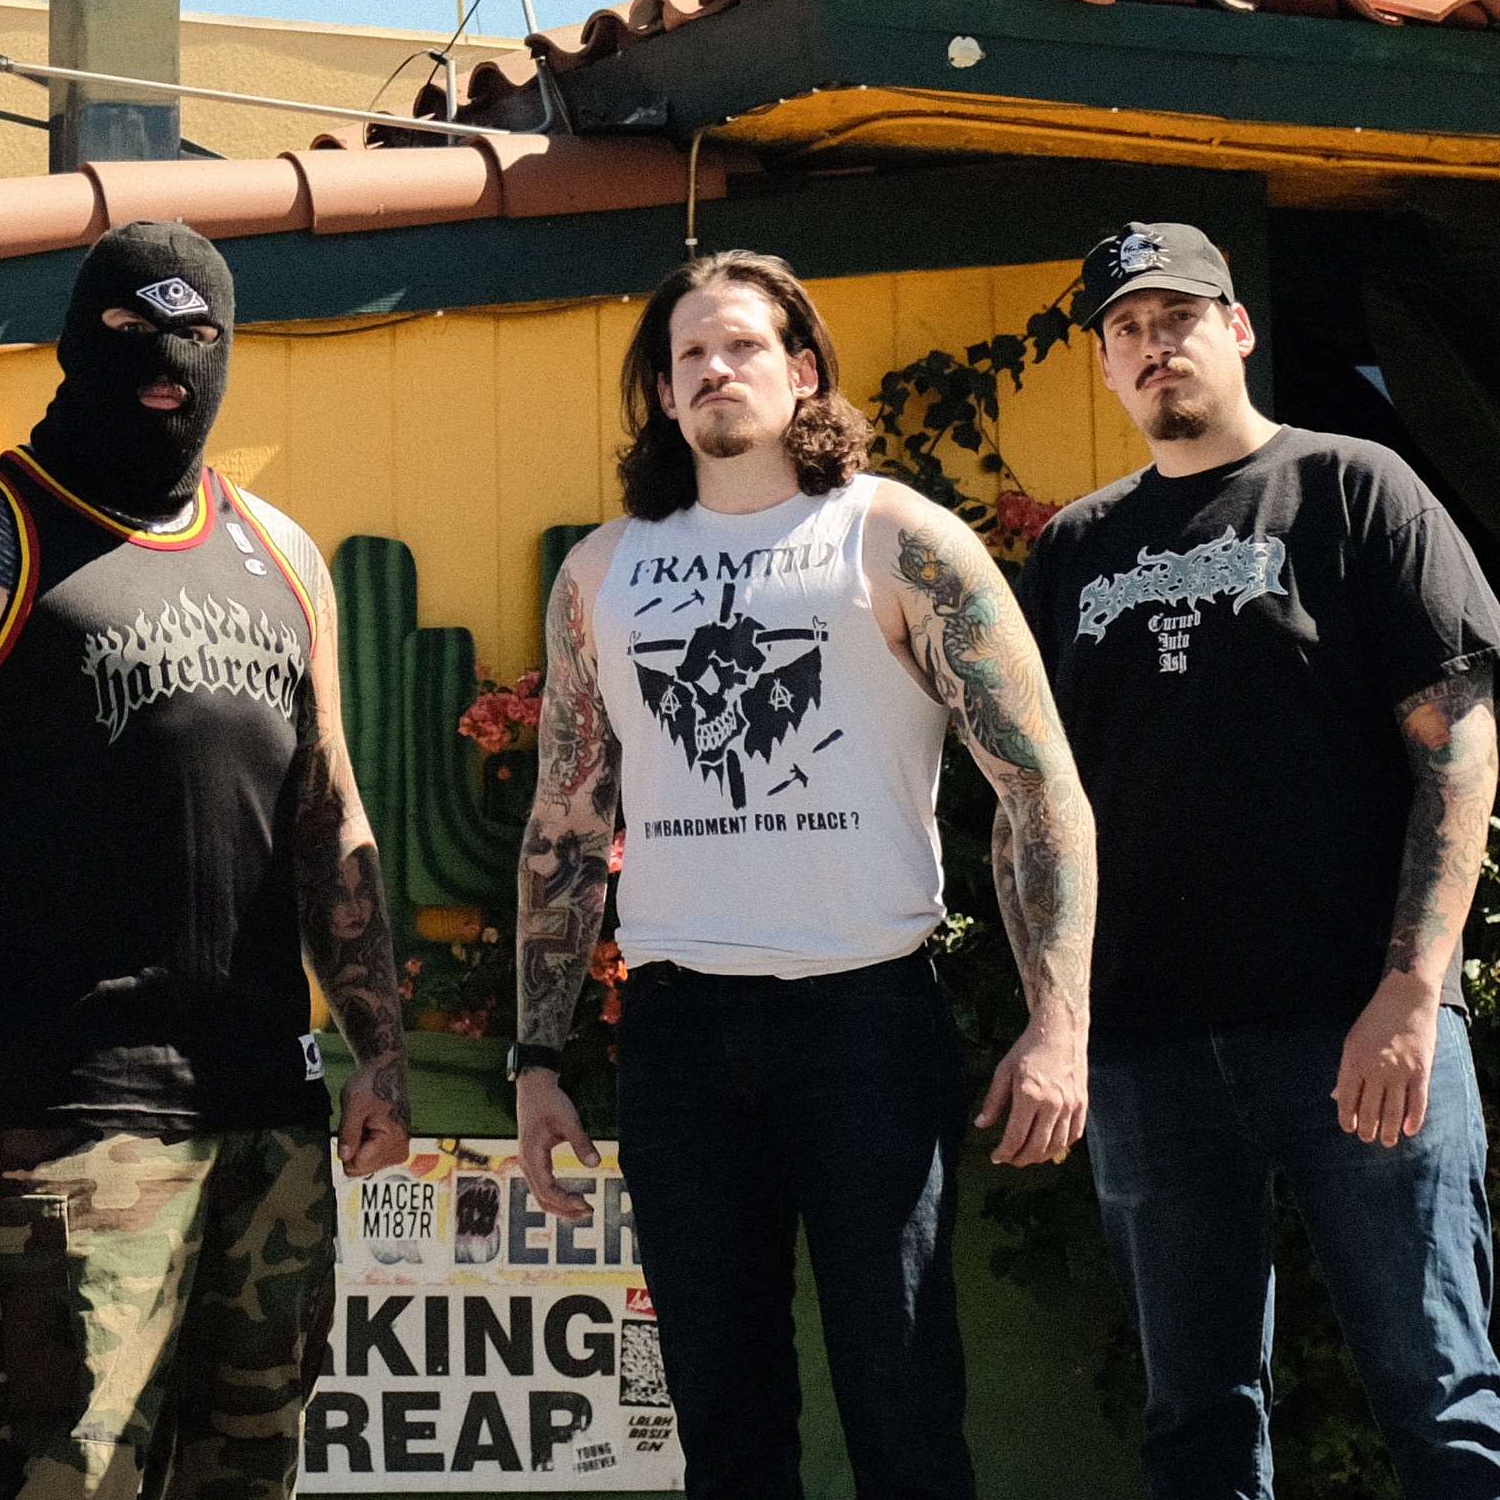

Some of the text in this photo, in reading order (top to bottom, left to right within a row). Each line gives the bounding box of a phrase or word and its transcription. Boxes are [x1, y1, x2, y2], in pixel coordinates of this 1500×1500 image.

[754, 813, 787, 832] FOR
[361, 1182, 435, 1211] MACER
[363, 1211, 432, 1239] M187R
[318, 1294, 616, 1379] KING
